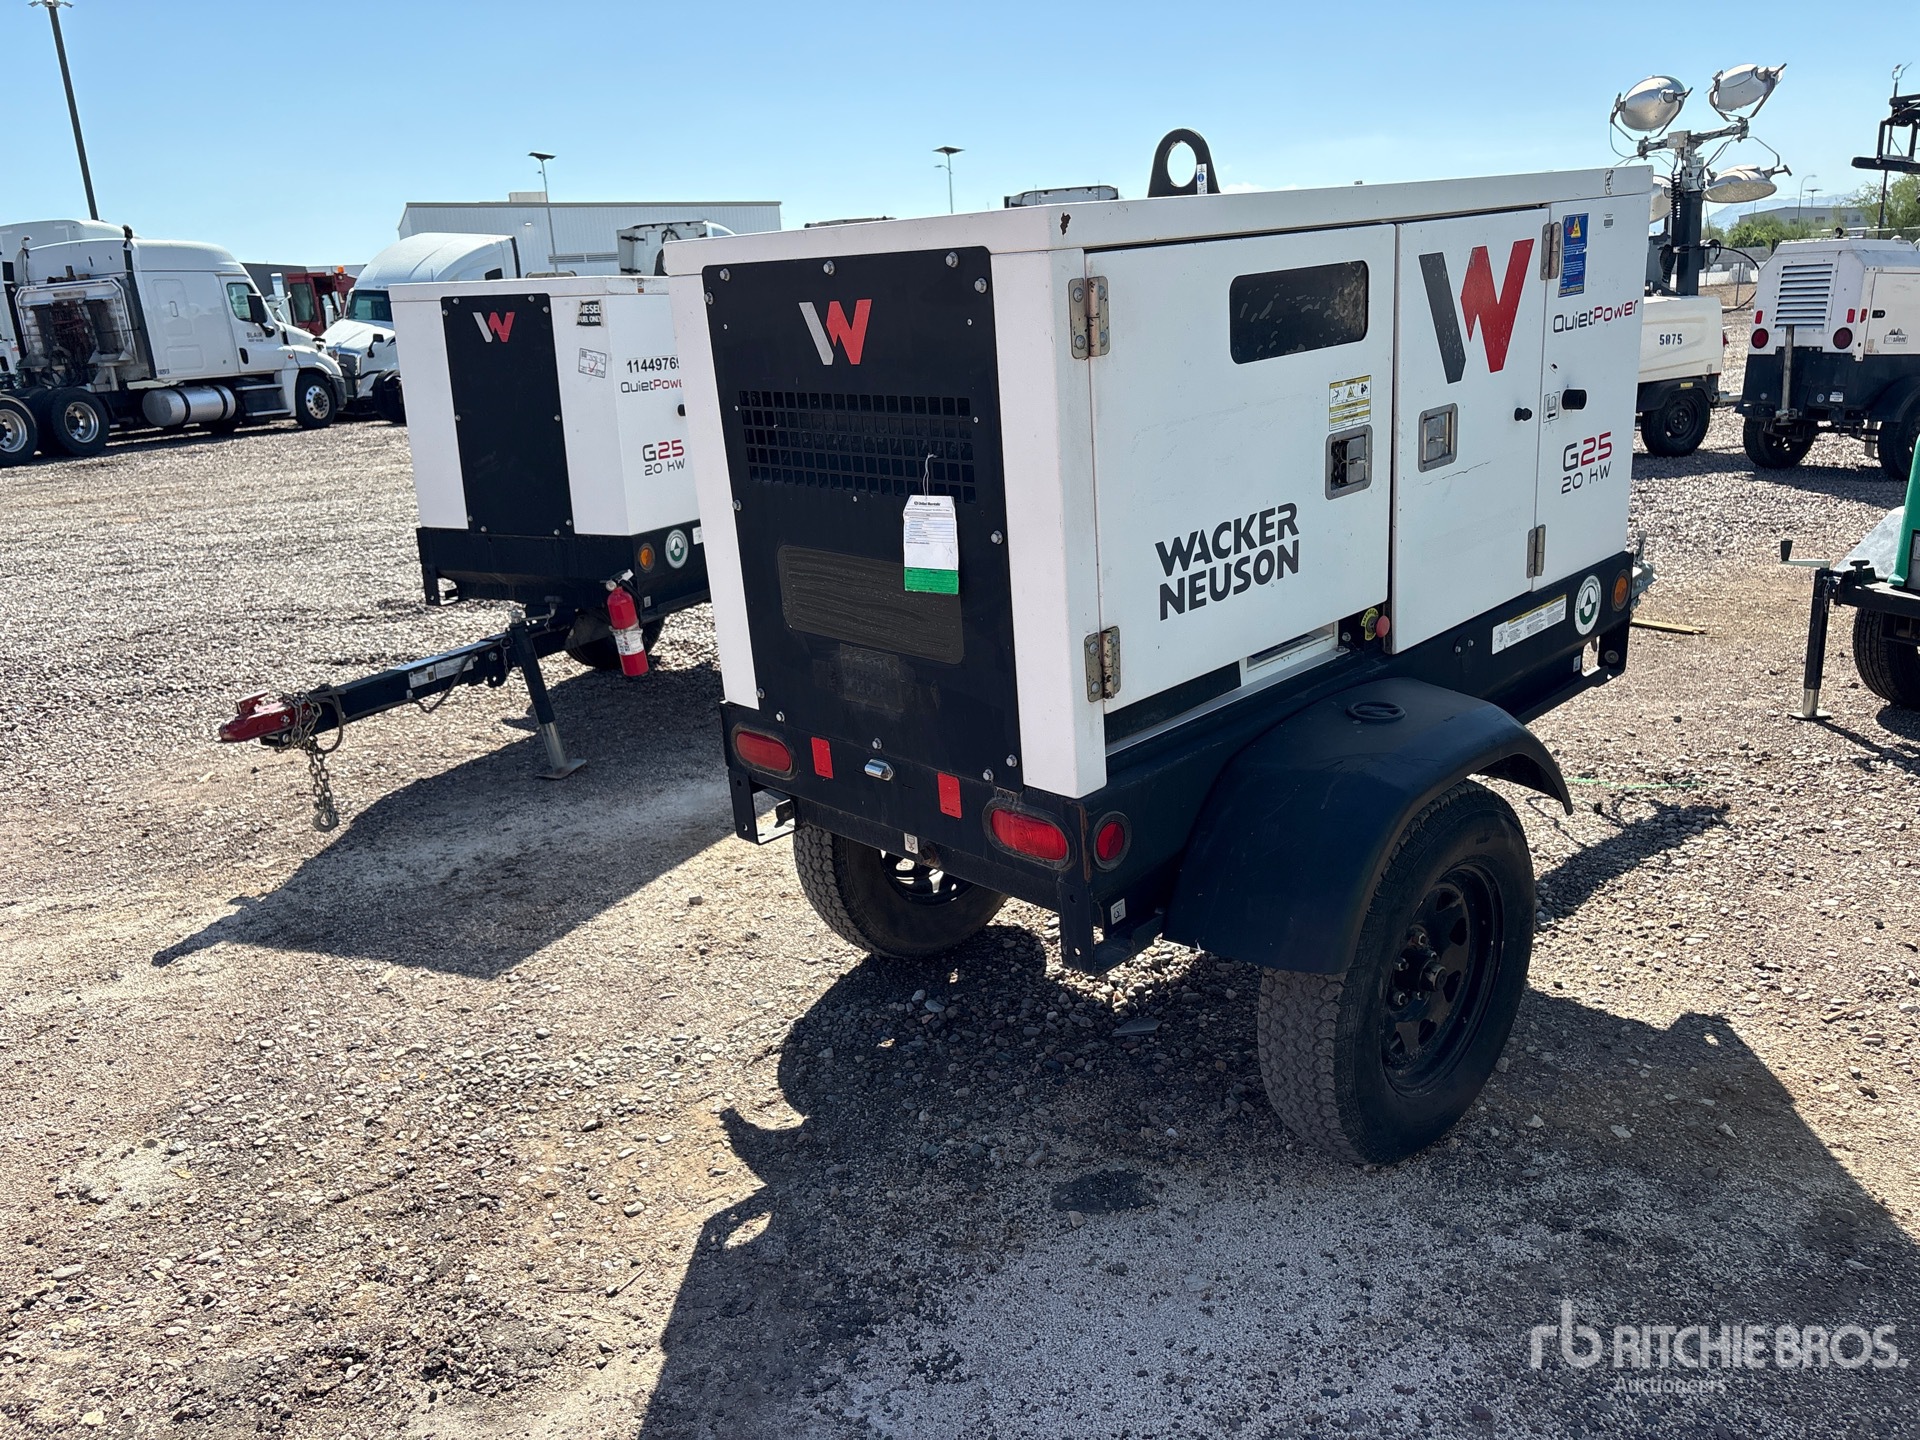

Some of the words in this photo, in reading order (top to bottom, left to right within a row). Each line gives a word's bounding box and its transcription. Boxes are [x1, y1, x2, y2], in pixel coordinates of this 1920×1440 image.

[1553, 299, 1639, 333] QuietPower
[642, 439, 684, 462] G25
[1563, 431, 1612, 472] G25
[644, 462, 663, 476] 20
[1561, 471, 1584, 494] 20
[1155, 502, 1299, 577] WACKER
[1159, 539, 1299, 621] NEUSON
